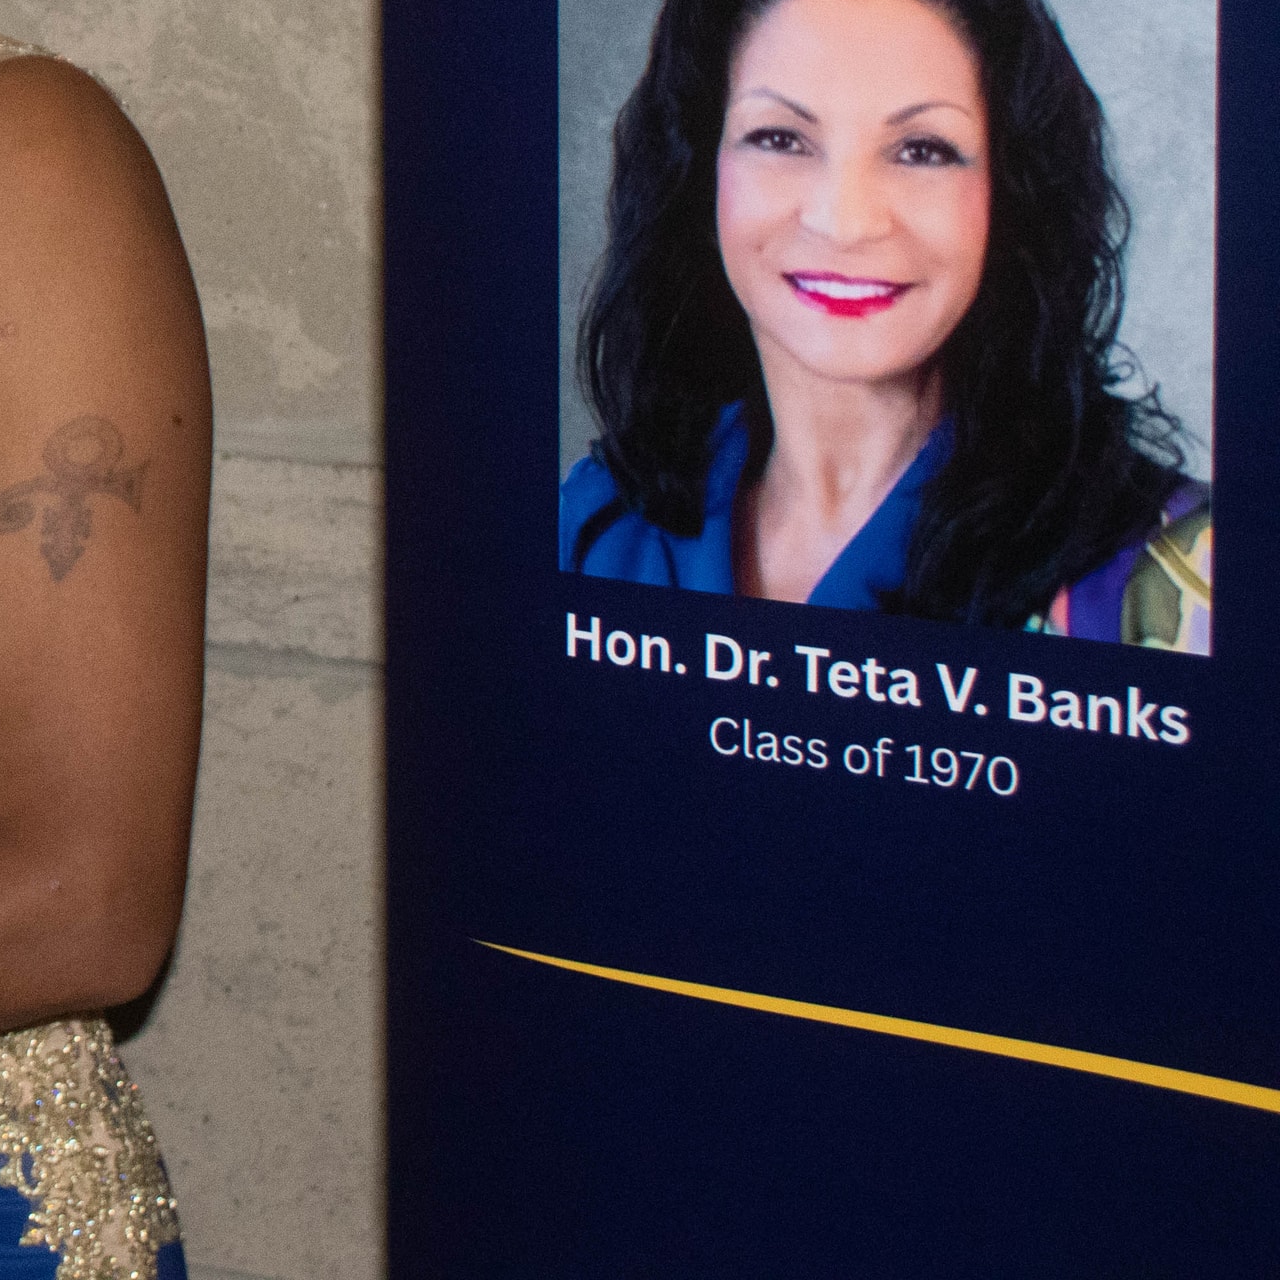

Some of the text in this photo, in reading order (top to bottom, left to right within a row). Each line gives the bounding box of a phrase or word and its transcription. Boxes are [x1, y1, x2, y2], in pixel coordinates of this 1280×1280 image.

[566, 612, 1190, 746] Hon. Dr. Teta V. Banks
[709, 717, 1019, 796] Class of 1970
